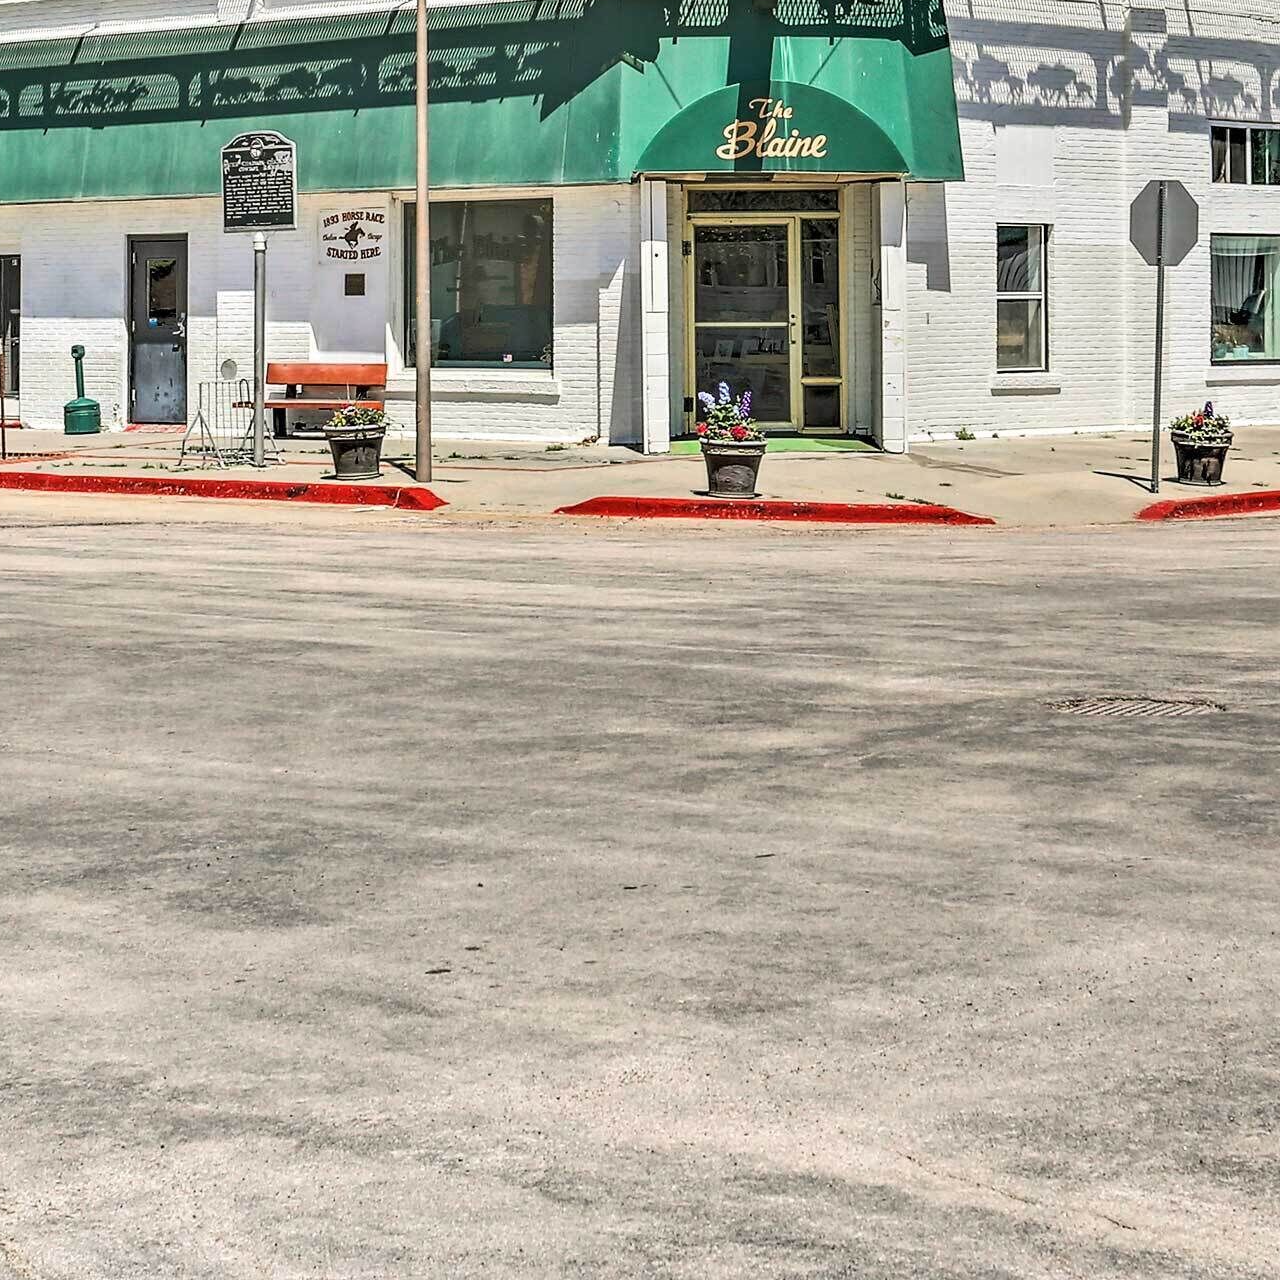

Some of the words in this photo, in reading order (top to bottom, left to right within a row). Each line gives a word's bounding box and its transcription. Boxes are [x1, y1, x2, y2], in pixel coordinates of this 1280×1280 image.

[748, 98, 793, 119] The
[715, 117, 827, 160] Blaine
[322, 214, 340, 228] 1893
[341, 211, 365, 222] HORSE
[365, 211, 385, 224] RACE
[326, 246, 359, 260] STARTED
[360, 246, 382, 260] HERE
